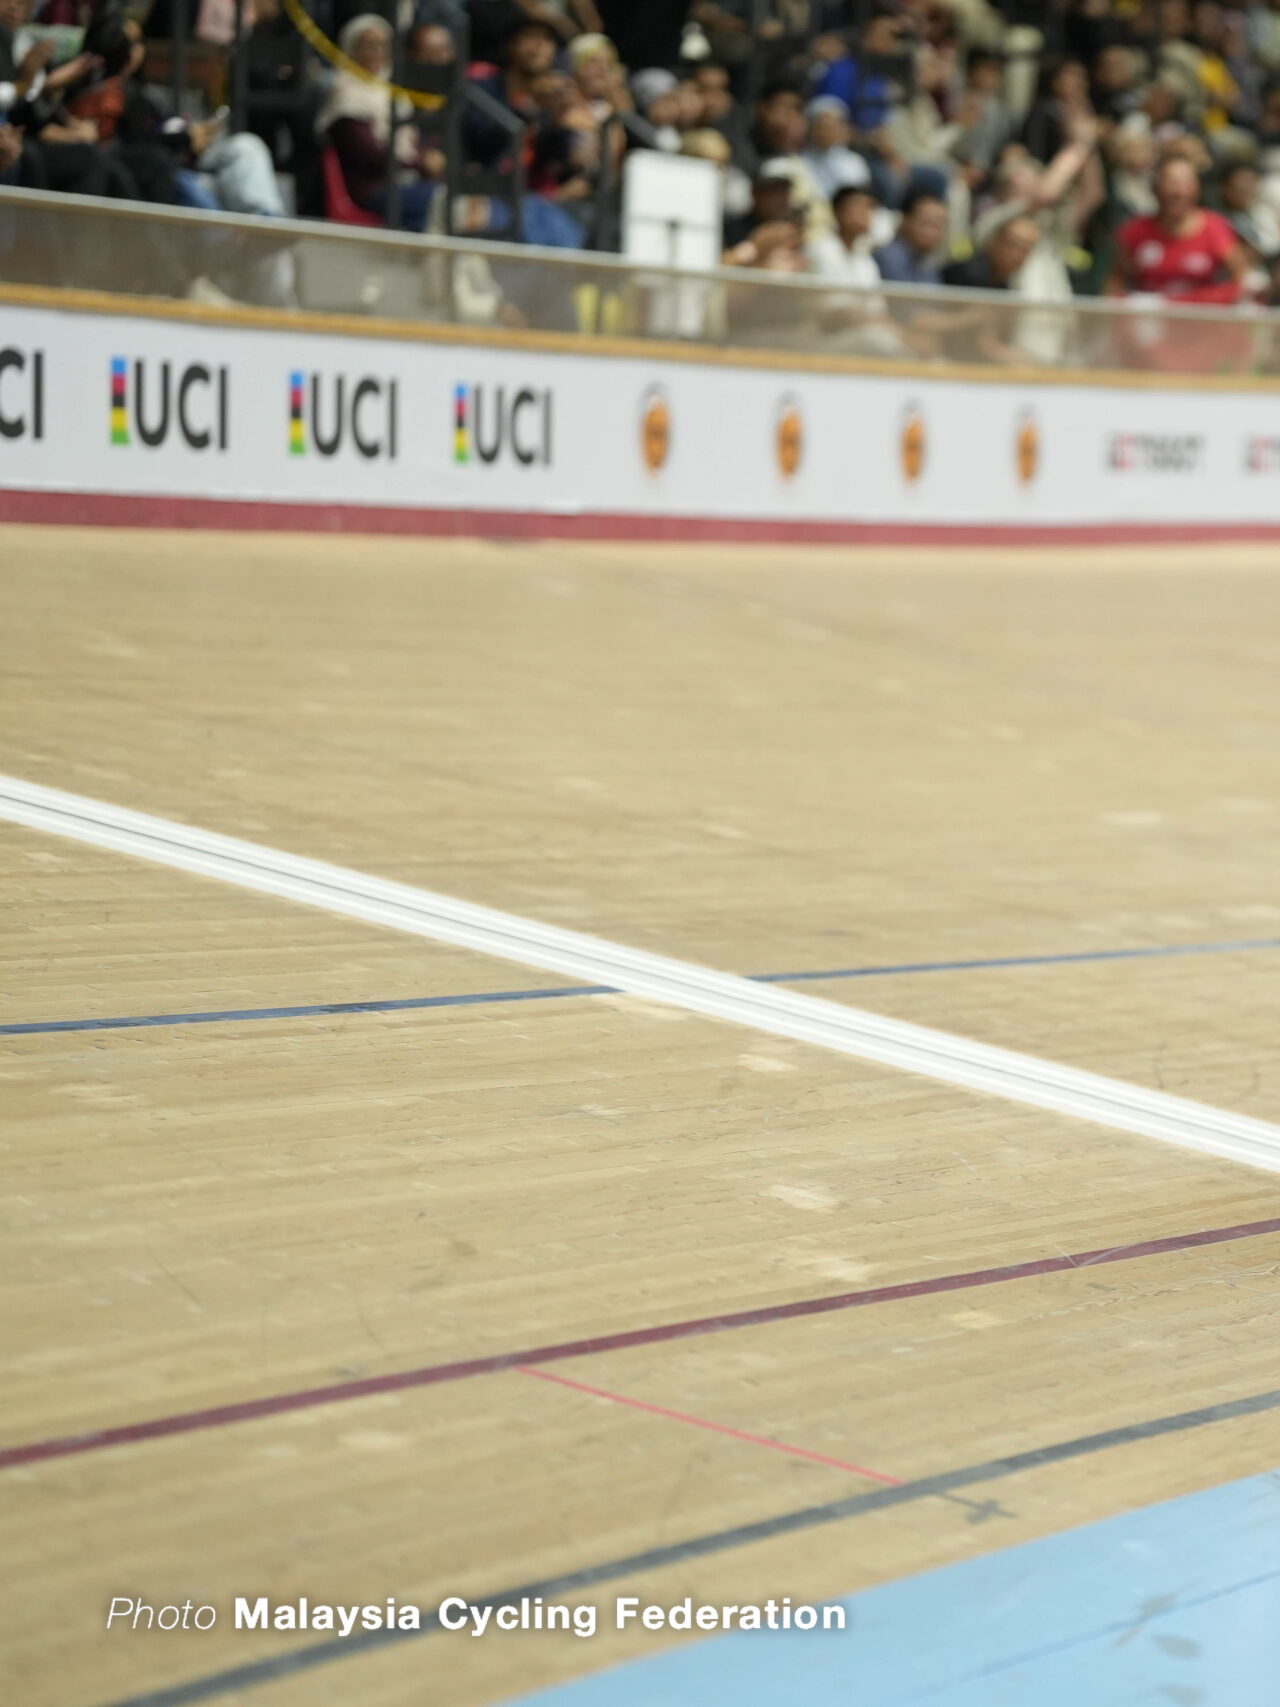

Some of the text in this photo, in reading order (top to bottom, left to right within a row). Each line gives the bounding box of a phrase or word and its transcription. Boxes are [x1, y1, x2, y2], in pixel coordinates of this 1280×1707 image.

[134, 358, 228, 451] UCI
[310, 373, 397, 460] UCI
[472, 385, 553, 467] UCI
